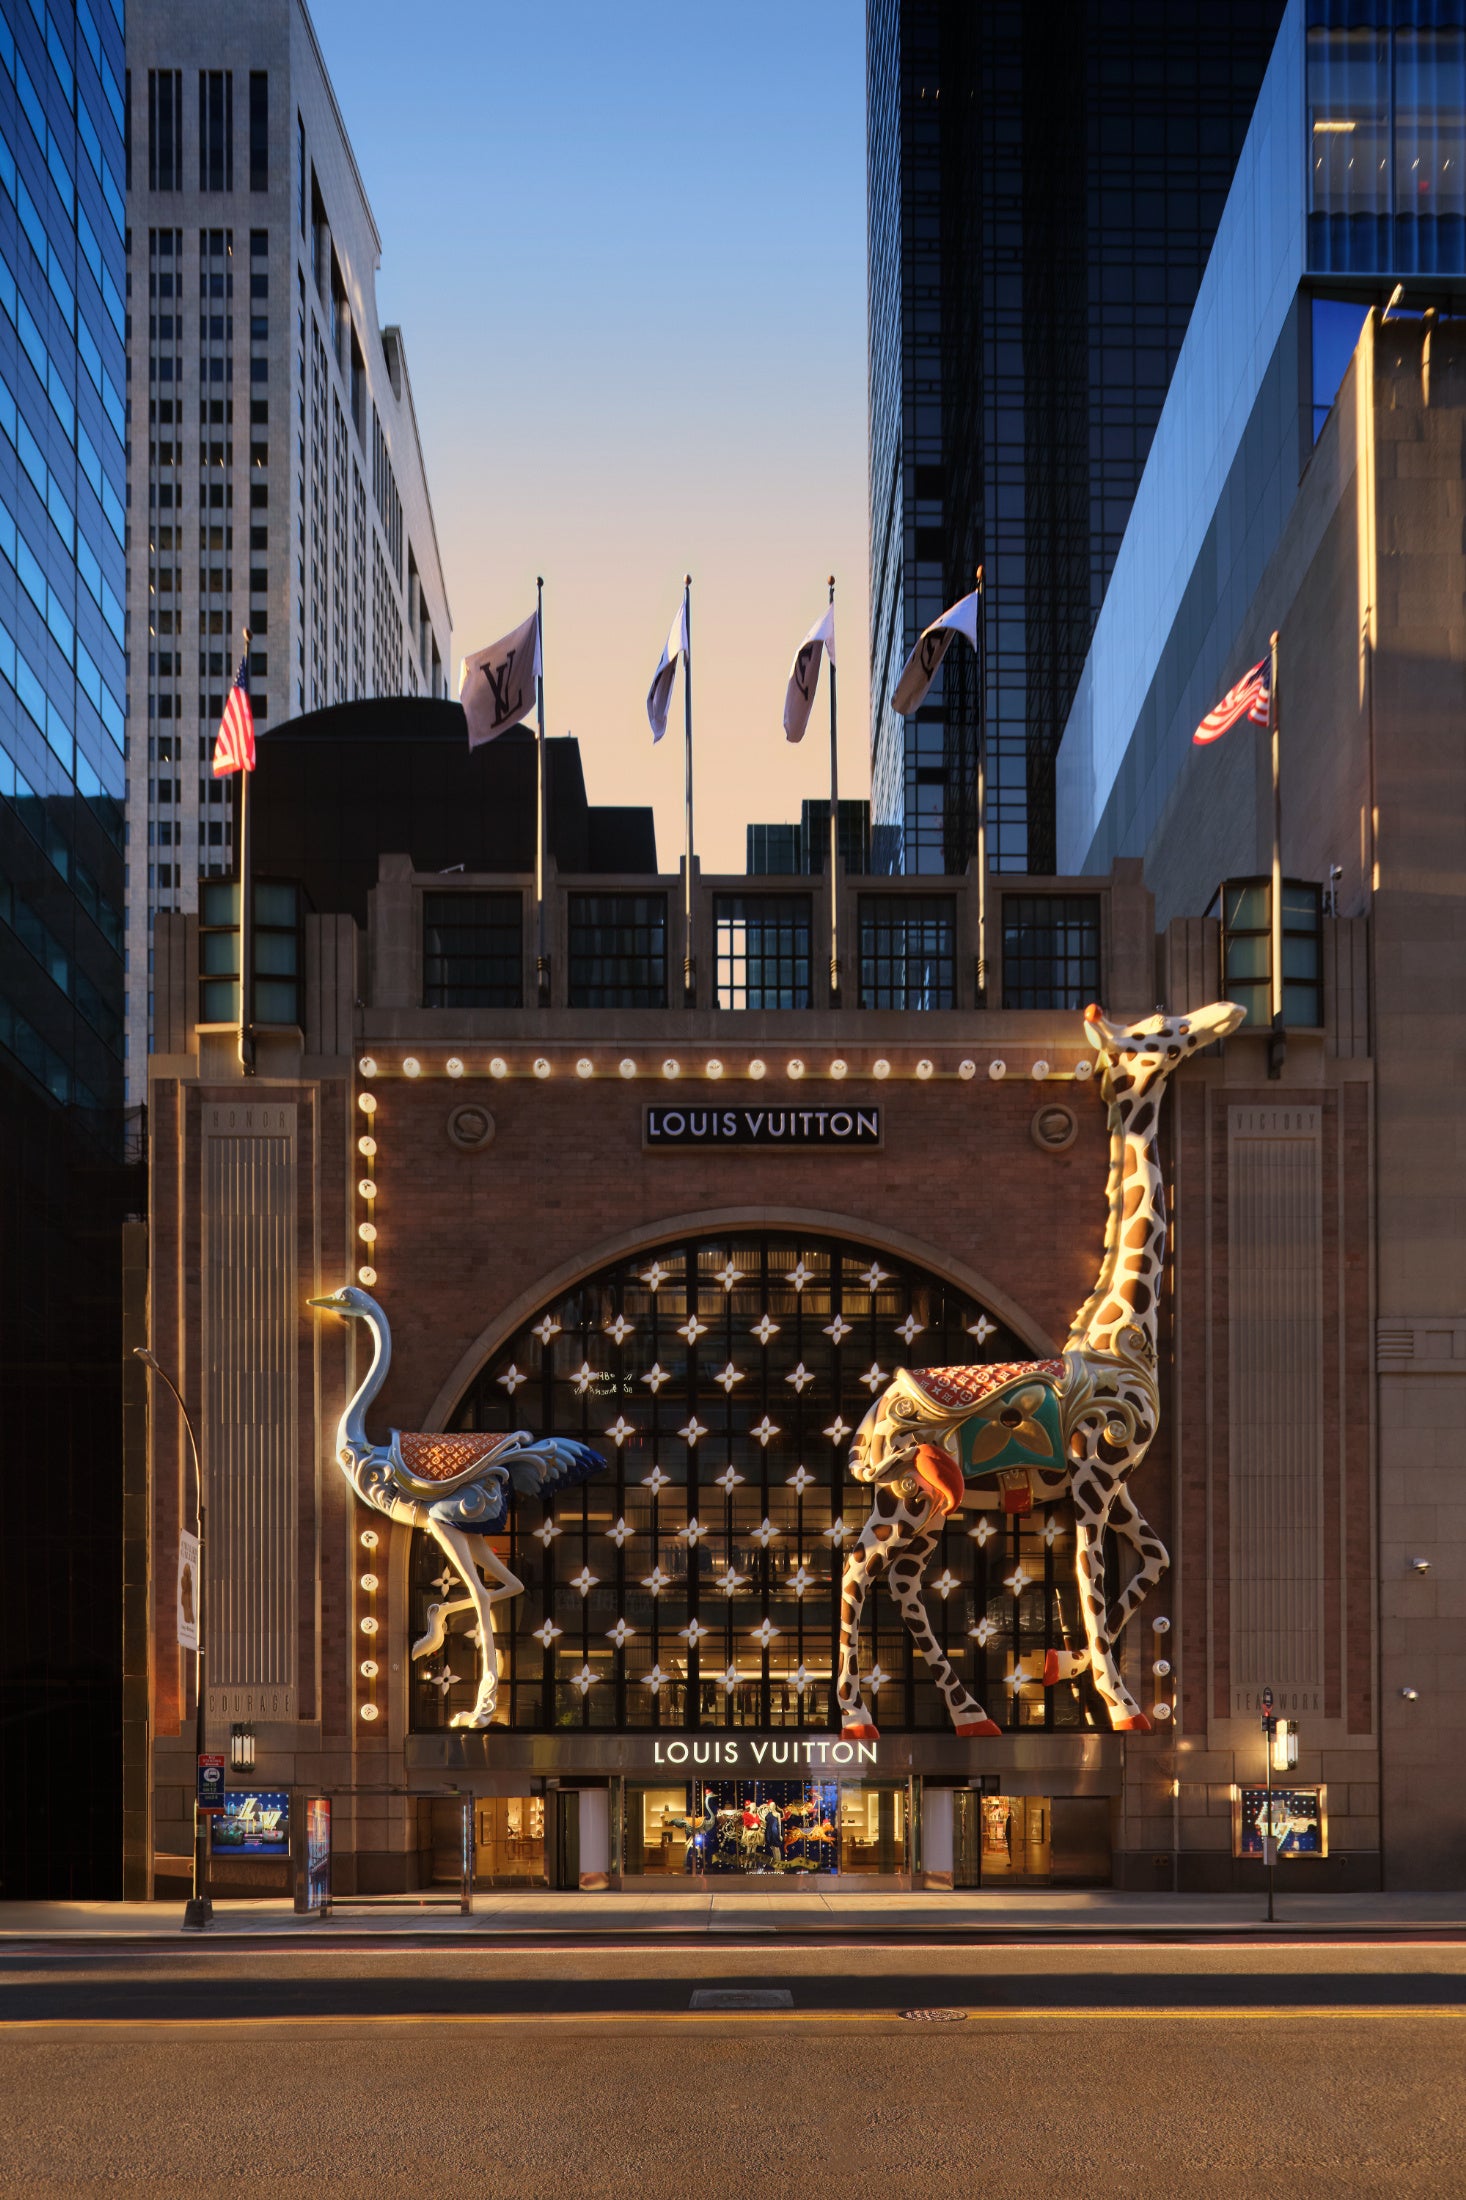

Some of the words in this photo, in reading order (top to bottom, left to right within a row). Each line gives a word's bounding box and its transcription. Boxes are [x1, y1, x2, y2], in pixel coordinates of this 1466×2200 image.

[213, 1111, 285, 1128] HONOR
[649, 1112, 738, 1136] LOUIS
[744, 1112, 878, 1137] VUITTON
[1237, 1113, 1314, 1130] VICTORY
[209, 1696, 289, 1712] COURAGE
[1236, 1693, 1319, 1710] TEAWORK
[654, 1741, 739, 1763] LOUIS
[750, 1741, 877, 1764] VUITTON
